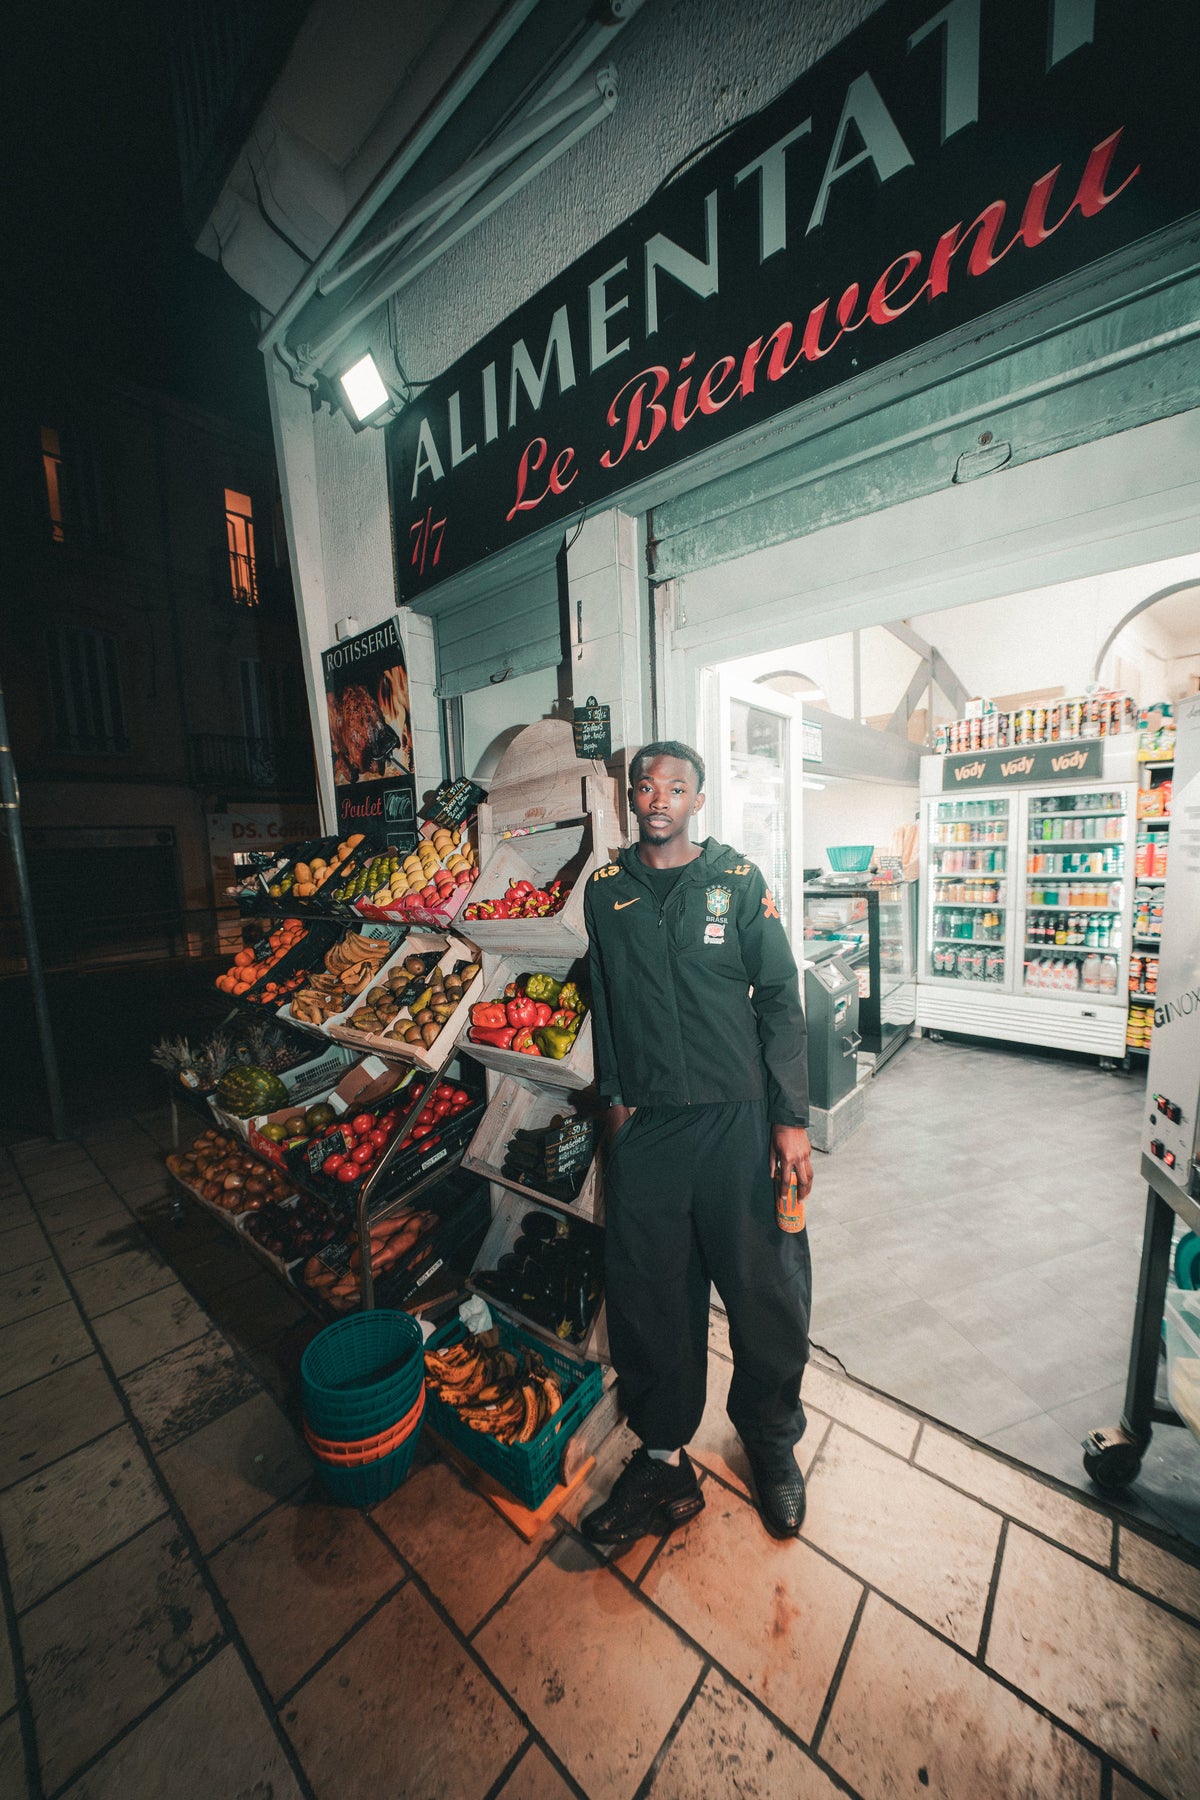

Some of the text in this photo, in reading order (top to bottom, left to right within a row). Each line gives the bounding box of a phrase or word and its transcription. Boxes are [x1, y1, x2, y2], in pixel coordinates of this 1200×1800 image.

[505, 125, 1141, 522] Le Bienvenu
[409, 506, 447, 576] 7/7
[326, 624, 398, 673] ROTISSERIE
[954, 750, 1089, 781] Vody Vody Vody
[341, 796, 383, 819] Poulet
[705, 915, 729, 925] BRASIL
